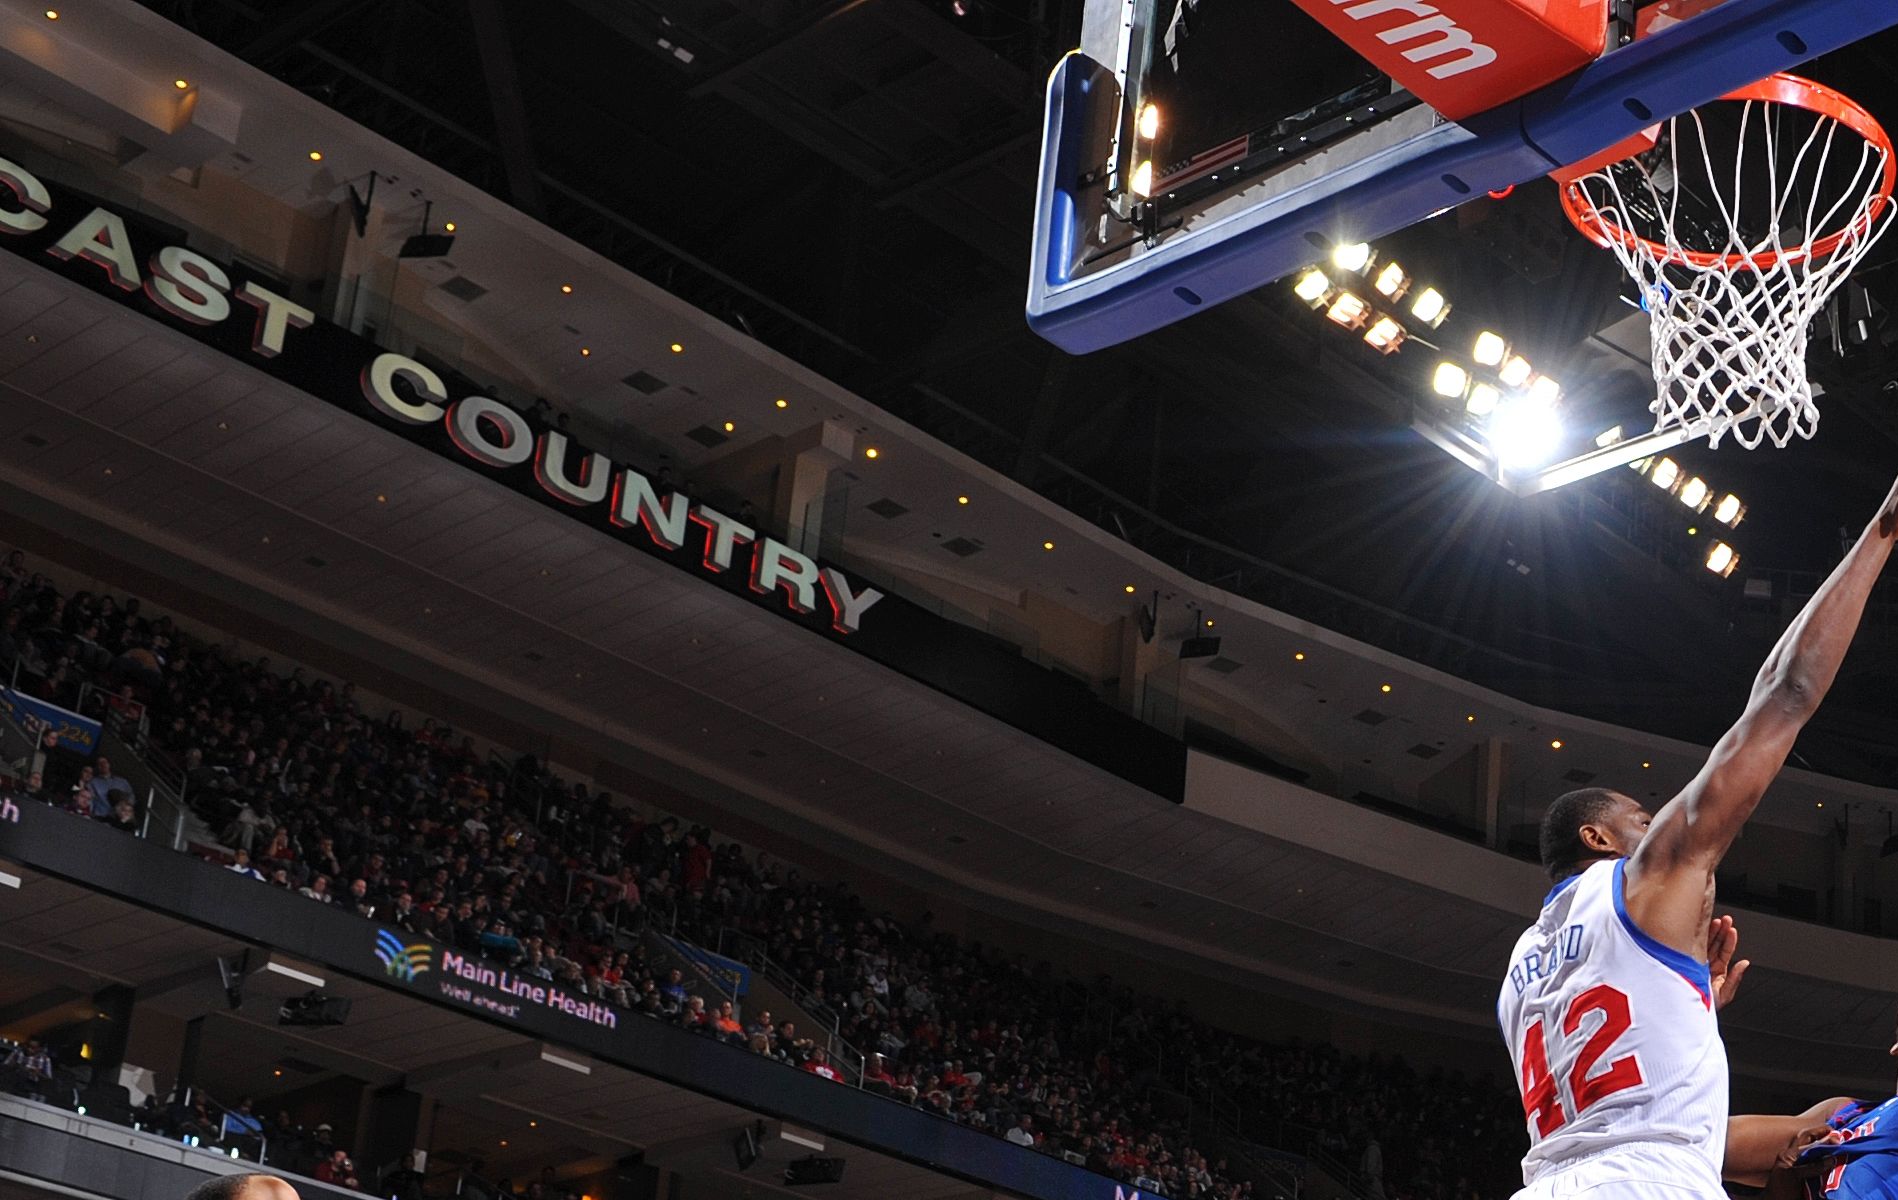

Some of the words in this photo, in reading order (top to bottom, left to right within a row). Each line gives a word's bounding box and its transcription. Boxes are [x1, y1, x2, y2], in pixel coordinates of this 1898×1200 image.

[1329, 0, 1497, 80] rm
[360, 352, 885, 634] COUNTRY
[442, 951, 496, 987] Main
[500, 971, 545, 1004] Line
[548, 988, 616, 1029] Health
[1521, 985, 1642, 1140] 42
